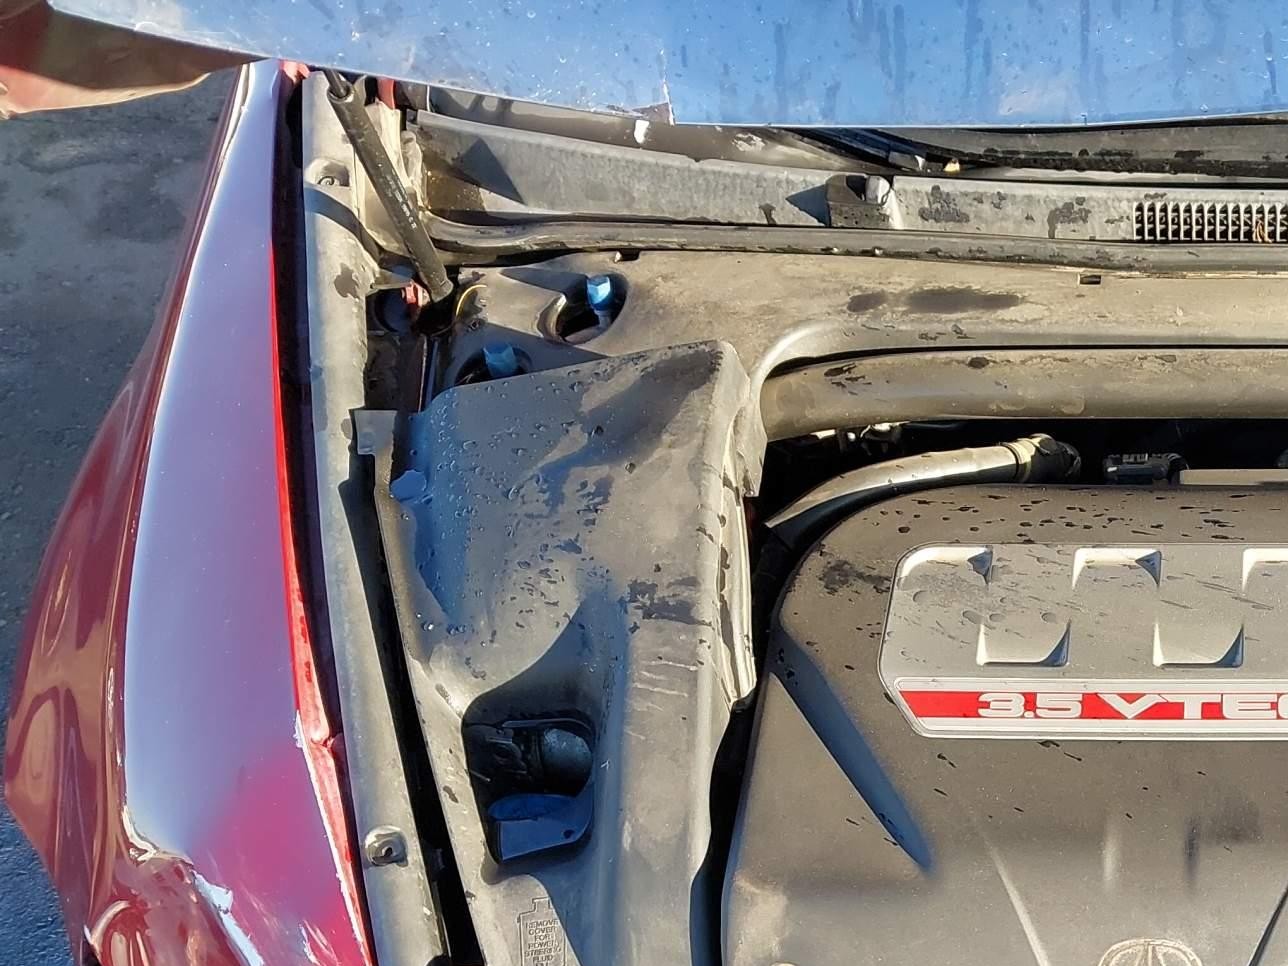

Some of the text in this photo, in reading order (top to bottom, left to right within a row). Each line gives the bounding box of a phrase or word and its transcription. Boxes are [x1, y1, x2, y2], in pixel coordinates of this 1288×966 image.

[977, 693, 1082, 719] 3.5
[526, 919, 558, 929] REMOVE
[529, 926, 556, 935] COVER
[528, 941, 560, 949] POWER
[533, 955, 554, 964] FLUID
